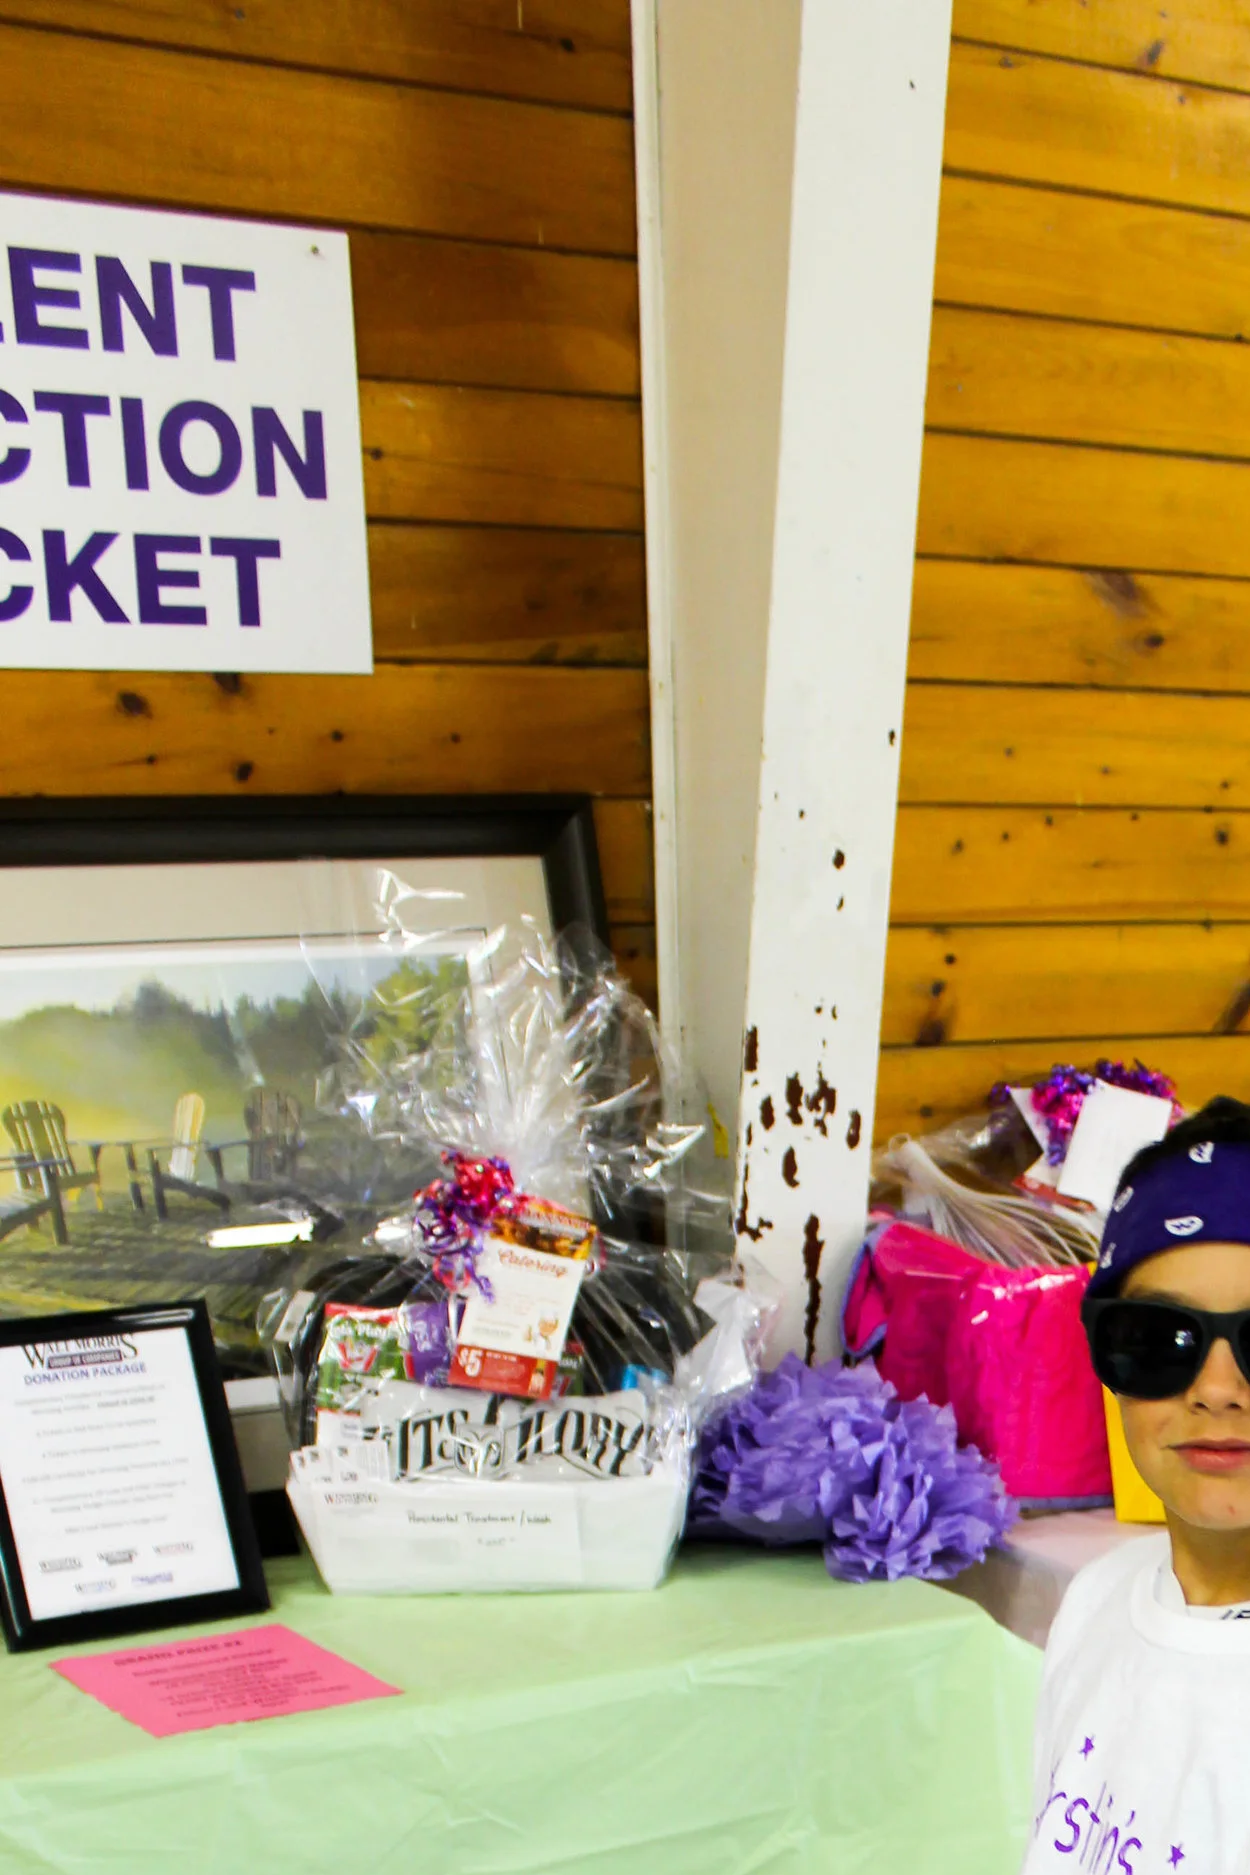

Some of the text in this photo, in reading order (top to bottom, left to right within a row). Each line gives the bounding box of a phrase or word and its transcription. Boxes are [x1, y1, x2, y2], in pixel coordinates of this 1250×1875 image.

[0, 245, 257, 363] ENT
[24, 1363, 147, 1385] DONATION PACKAGE
